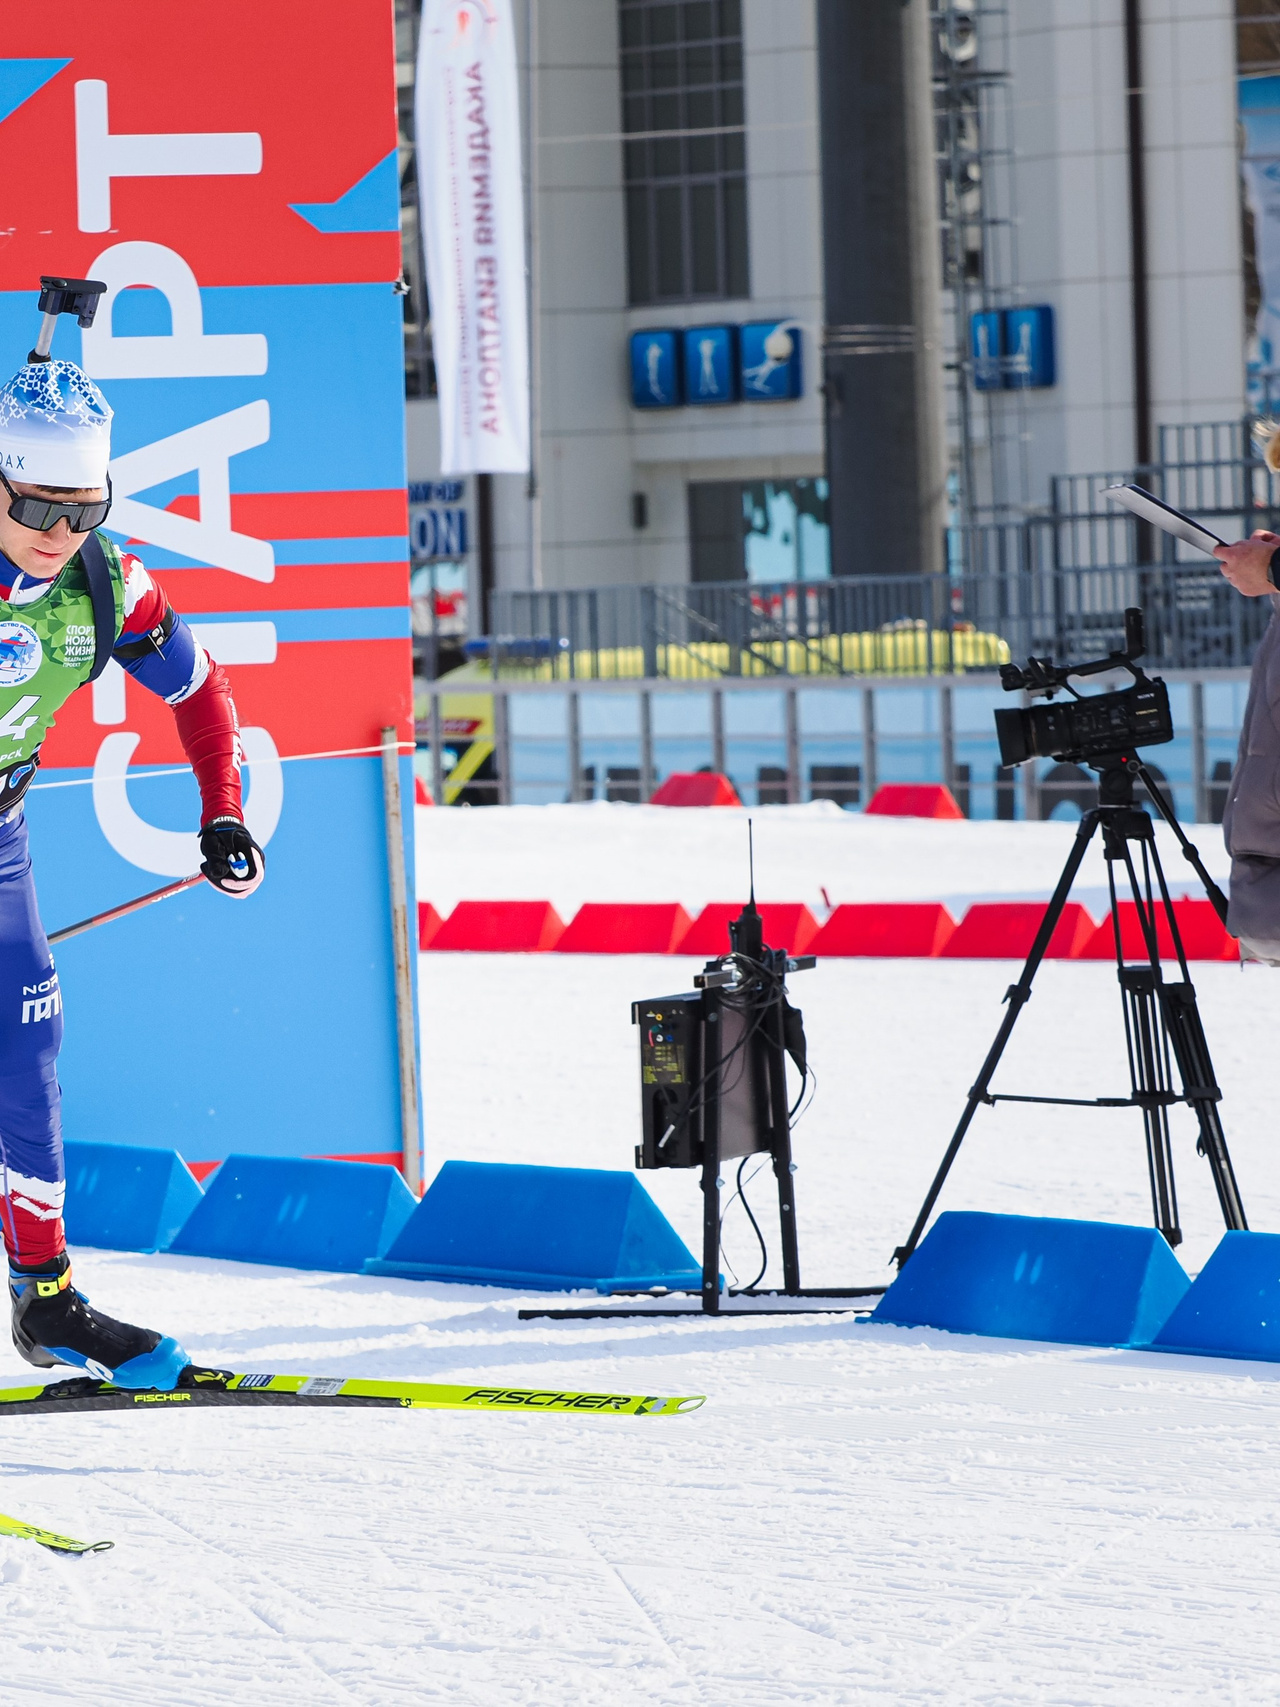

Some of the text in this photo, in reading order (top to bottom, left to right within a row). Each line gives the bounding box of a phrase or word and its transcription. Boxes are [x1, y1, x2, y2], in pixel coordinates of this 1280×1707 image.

[20, 624, 39, 643] РОССИИ
[66, 625, 95, 635] СПОРТ
[134, 1393, 191, 1403] FISCHER
[463, 1390, 631, 1410] FISCHER
